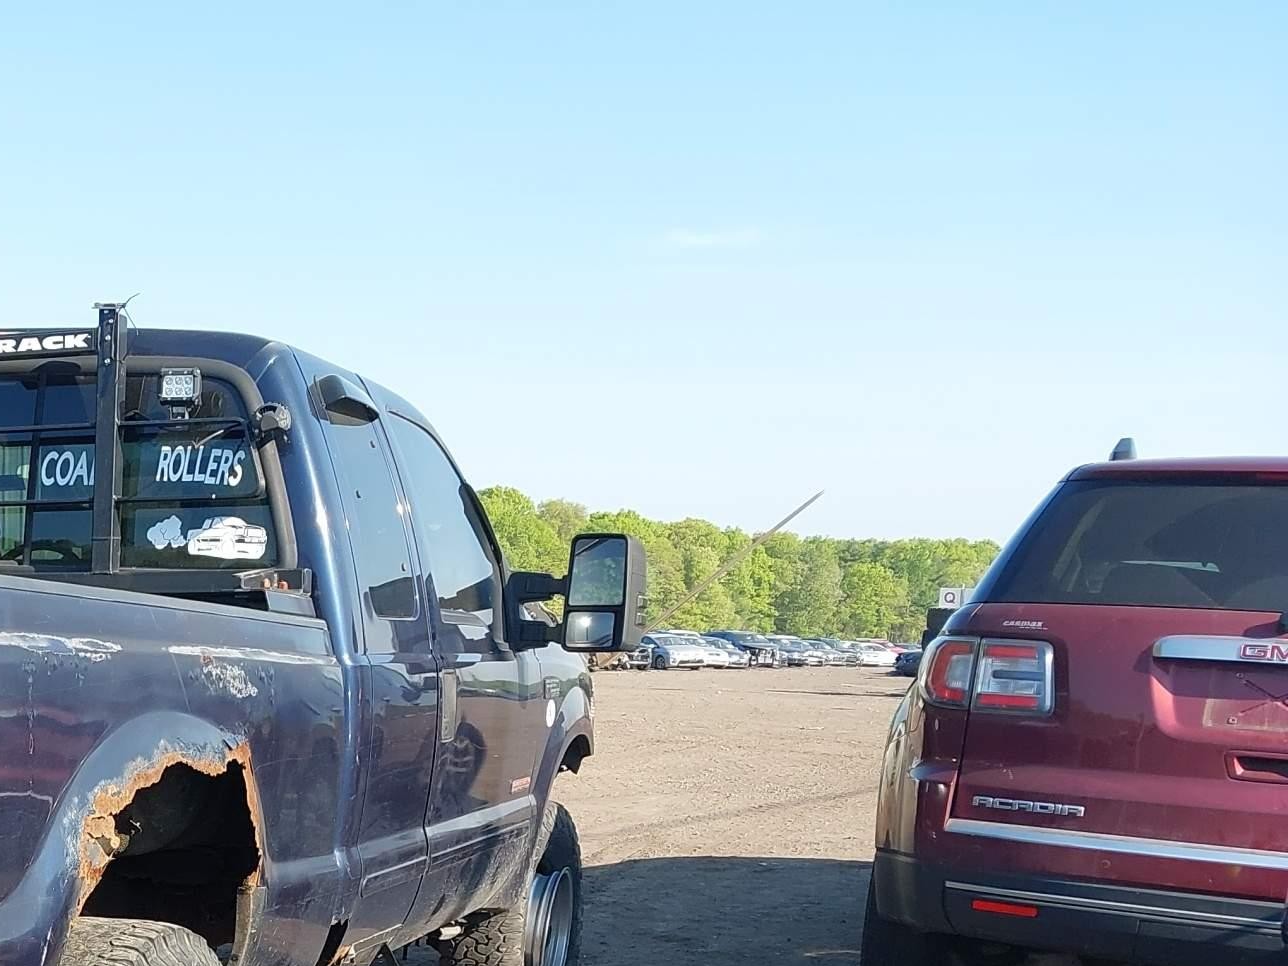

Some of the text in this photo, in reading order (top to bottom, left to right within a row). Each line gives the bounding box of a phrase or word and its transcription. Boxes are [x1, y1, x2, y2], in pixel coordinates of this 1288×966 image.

[155, 445, 246, 487] ROLLERS
[944, 592, 956, 604] Q
[972, 795, 1085, 817] ACADIA
